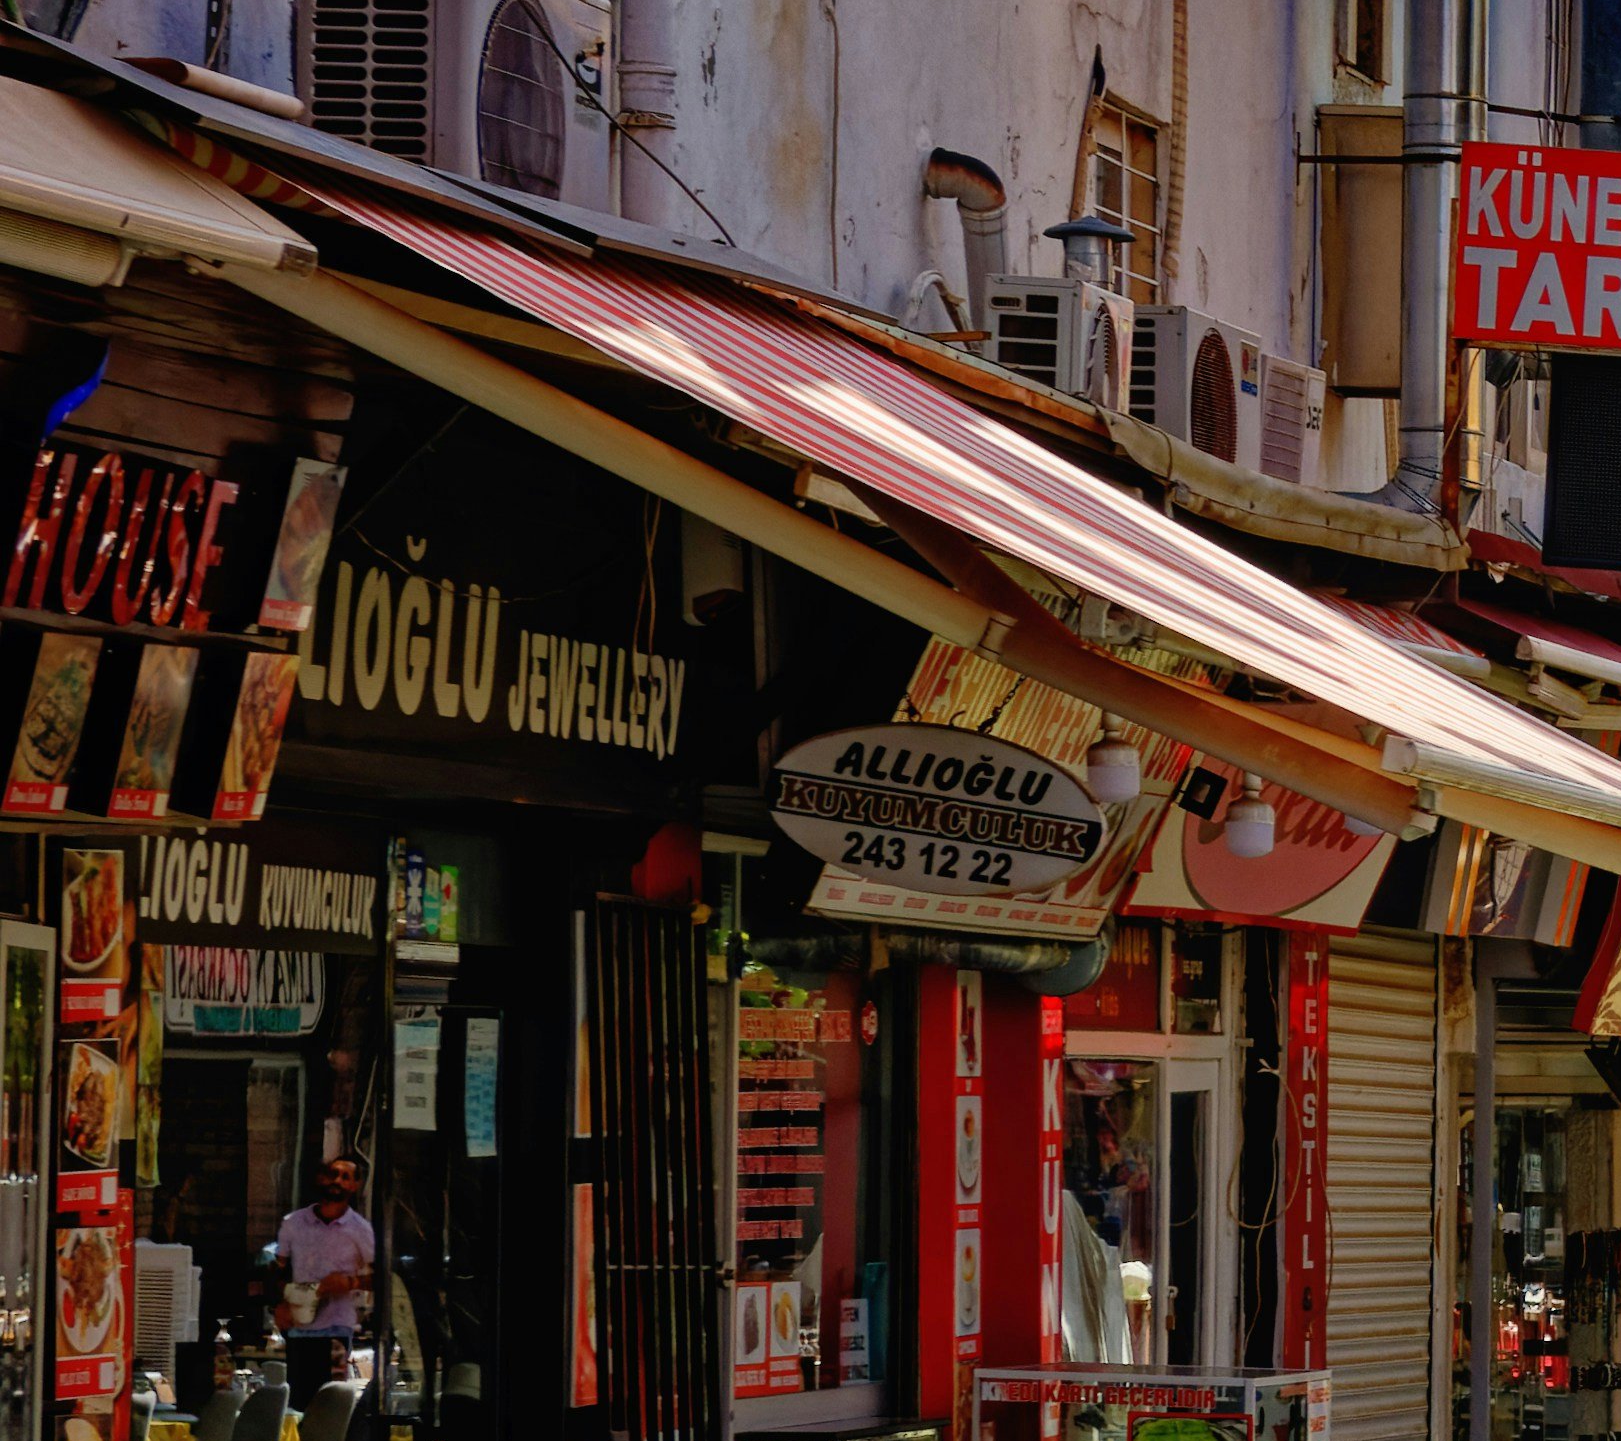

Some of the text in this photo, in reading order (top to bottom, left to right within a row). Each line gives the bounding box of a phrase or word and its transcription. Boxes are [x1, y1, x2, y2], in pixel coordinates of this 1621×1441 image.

[2, 449, 241, 631] HOUSE
[507, 628, 686, 762] JEWELLERY
[833, 741, 1054, 806] ALLIOĞLU
[776, 775, 1089, 859] KUYUMCULUK
[841, 831, 1014, 886] 243 12 22
[258, 862, 378, 941] KUYUMCULUK
[1303, 951, 1319, 1270] TEKSTİL
